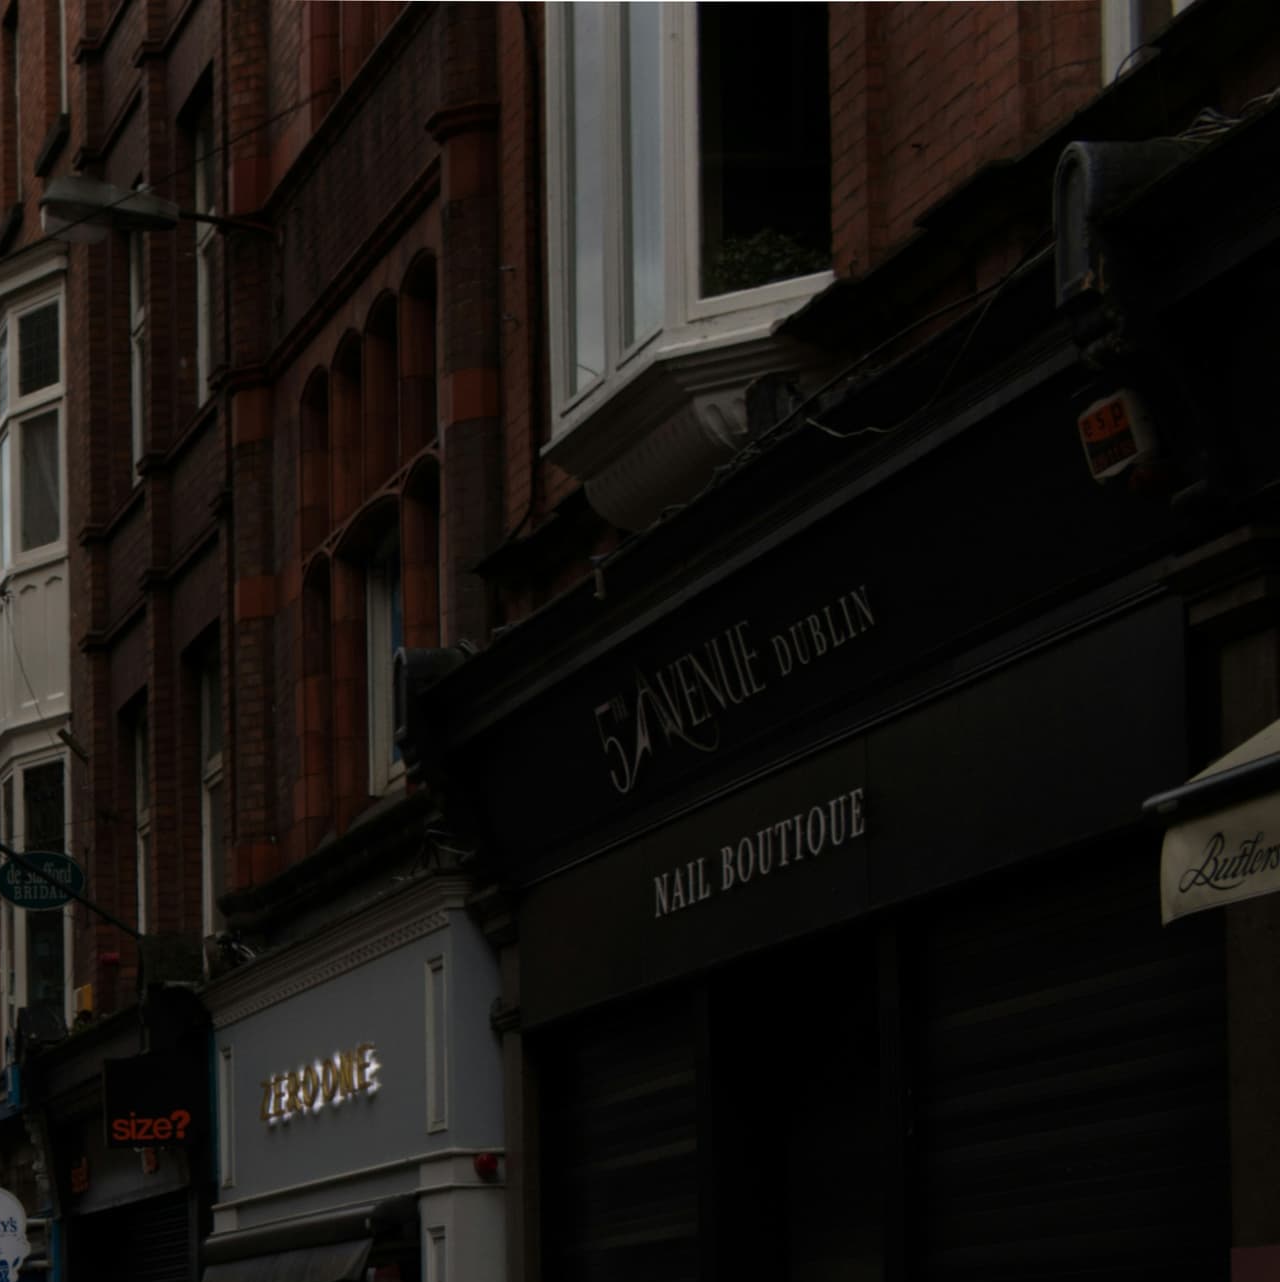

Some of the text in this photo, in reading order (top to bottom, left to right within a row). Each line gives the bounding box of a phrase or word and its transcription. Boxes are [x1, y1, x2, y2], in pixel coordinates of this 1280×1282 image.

[770, 583, 877, 678] DUBLIN
[654, 787, 865, 918] NAIL BOUTIQUE
[1178, 831, 1280, 893] Butlers
[111, 1108, 191, 1141] size?
